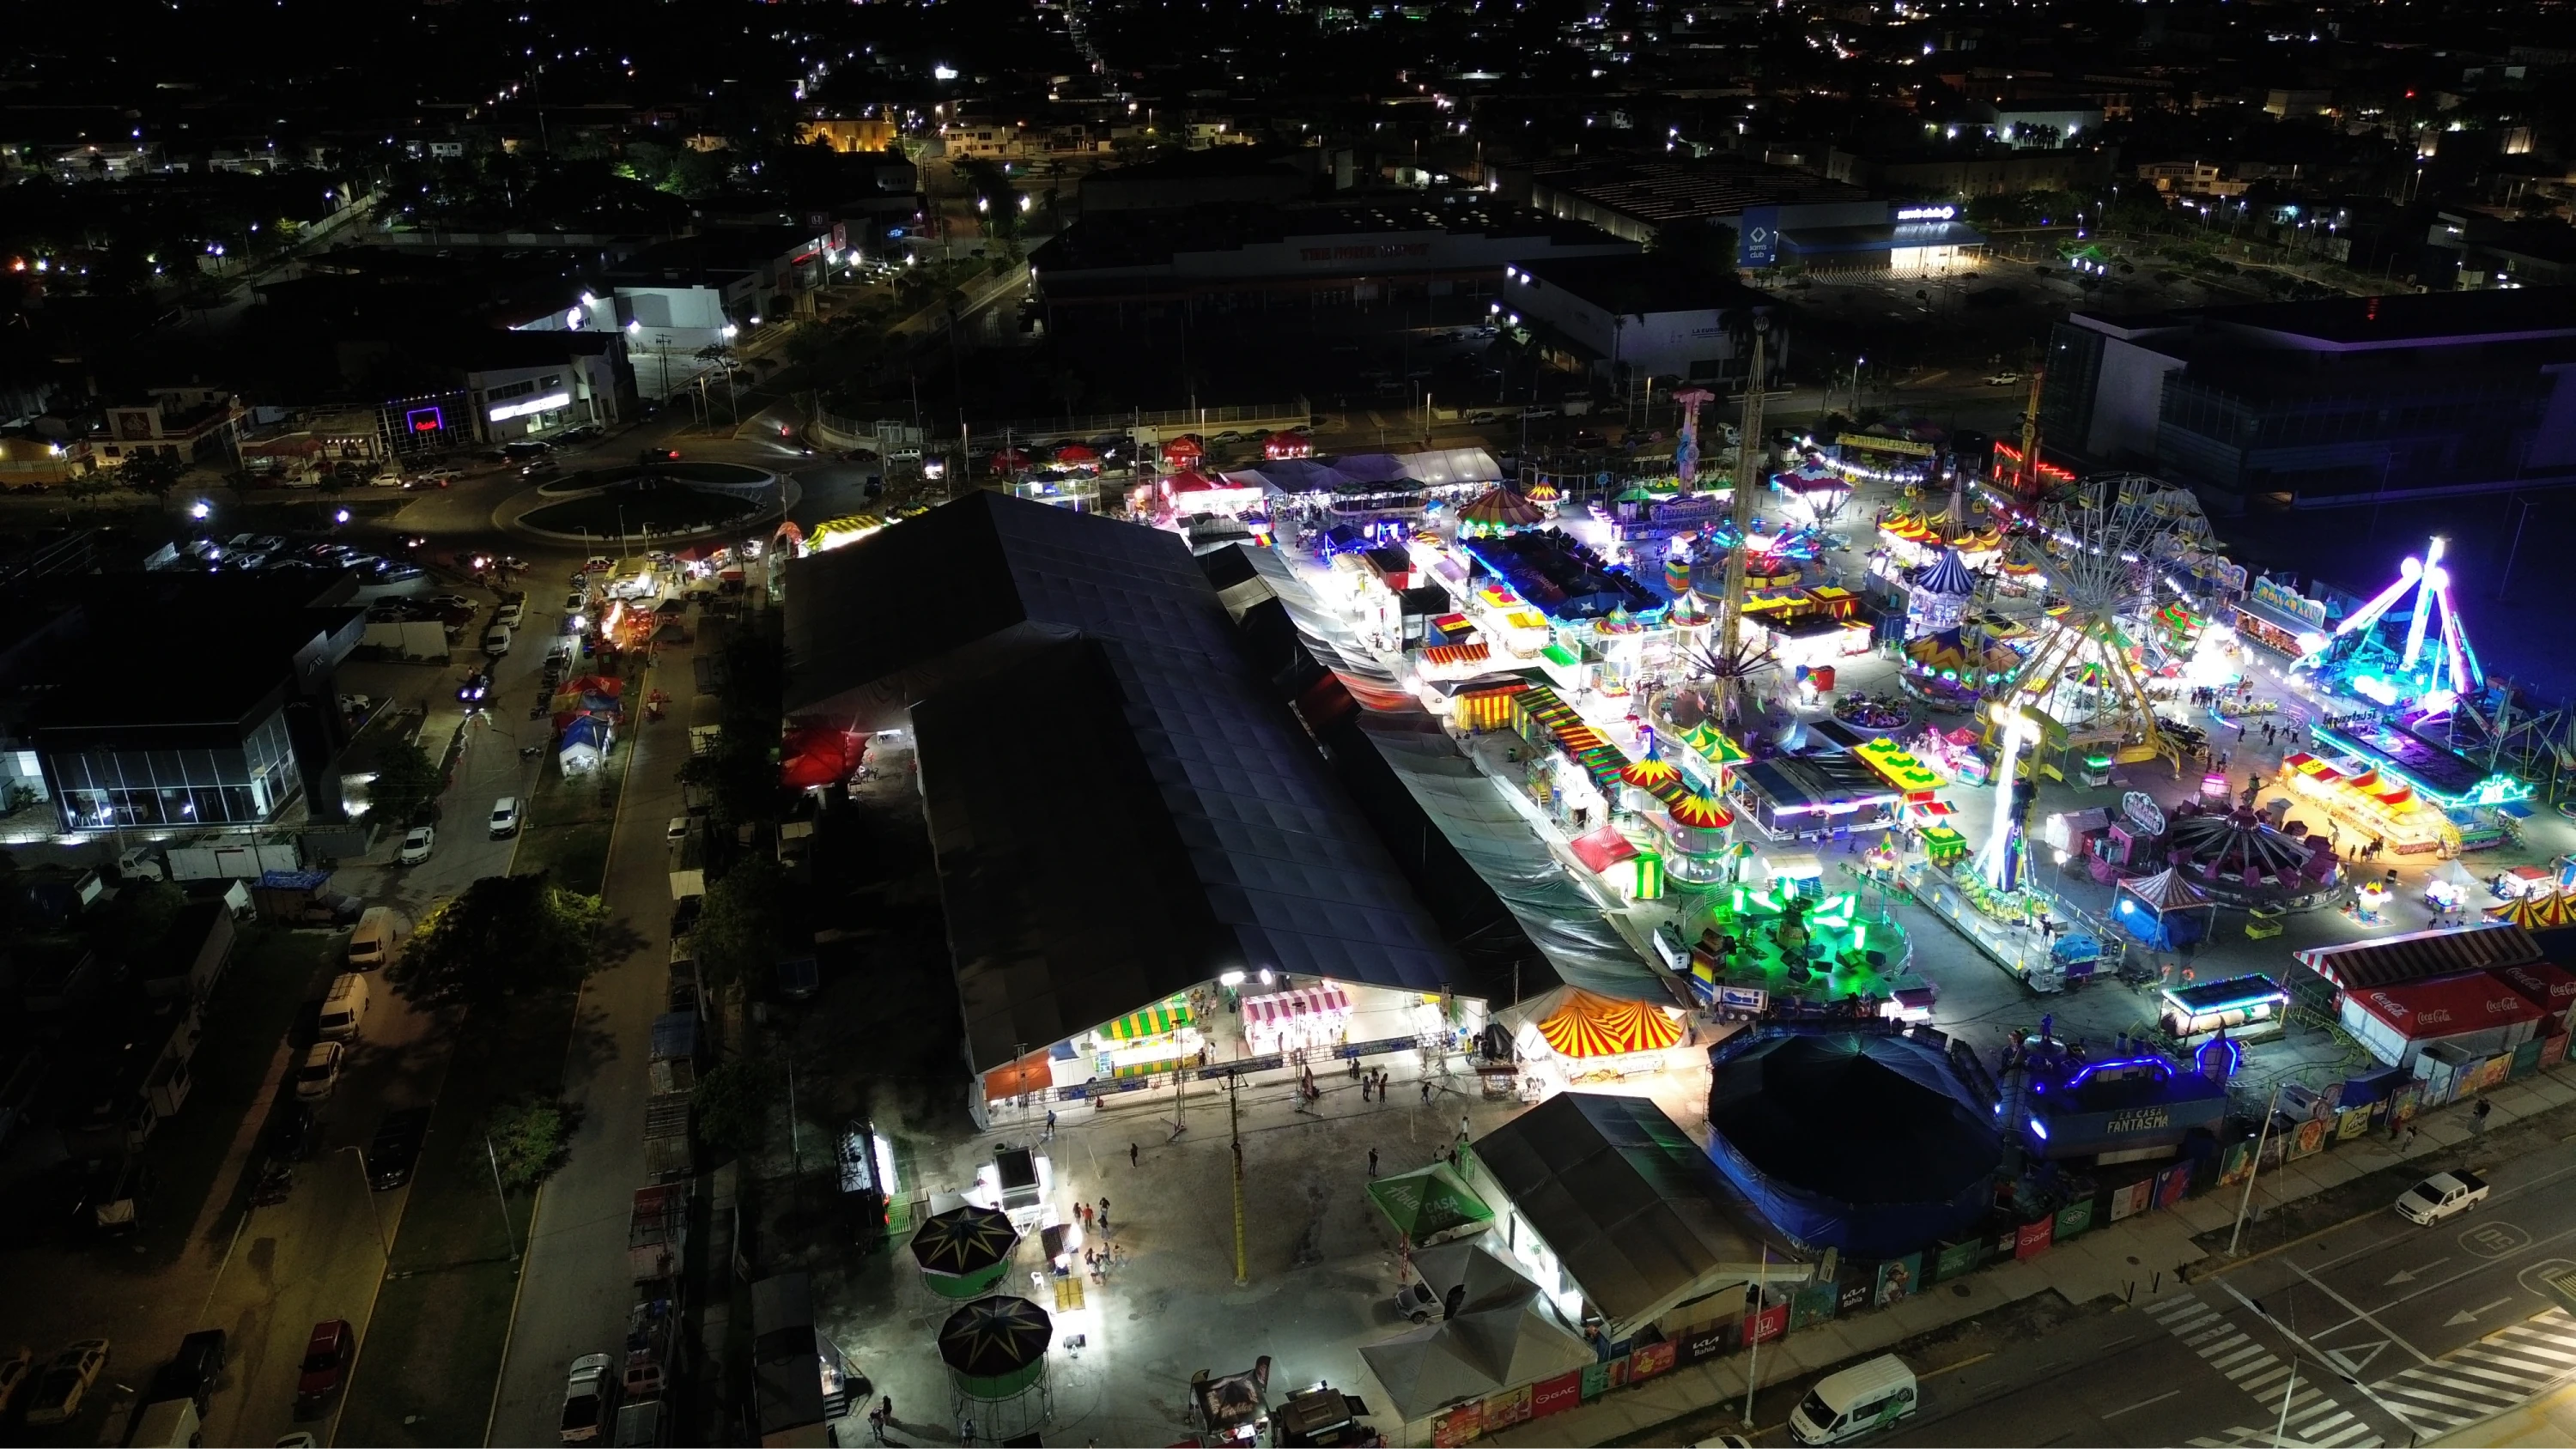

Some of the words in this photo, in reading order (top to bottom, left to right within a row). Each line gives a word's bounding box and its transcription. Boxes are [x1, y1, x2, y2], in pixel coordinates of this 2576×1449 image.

[1300, 248, 1331, 261] THE
[1334, 246, 1376, 259] HOME
[1358, 1045, 1393, 1055] ENTRADA
[1085, 1087, 1122, 1095] ENTRADA
[2119, 1111, 2131, 1120] LA
[2136, 1107, 2162, 1119] CASA
[2106, 1115, 2169, 1133] FANTASMA
[1425, 1195, 1459, 1214] CASA
[2033, 1228, 2050, 1243] GAC
[1551, 1386, 1577, 1400] GAC
